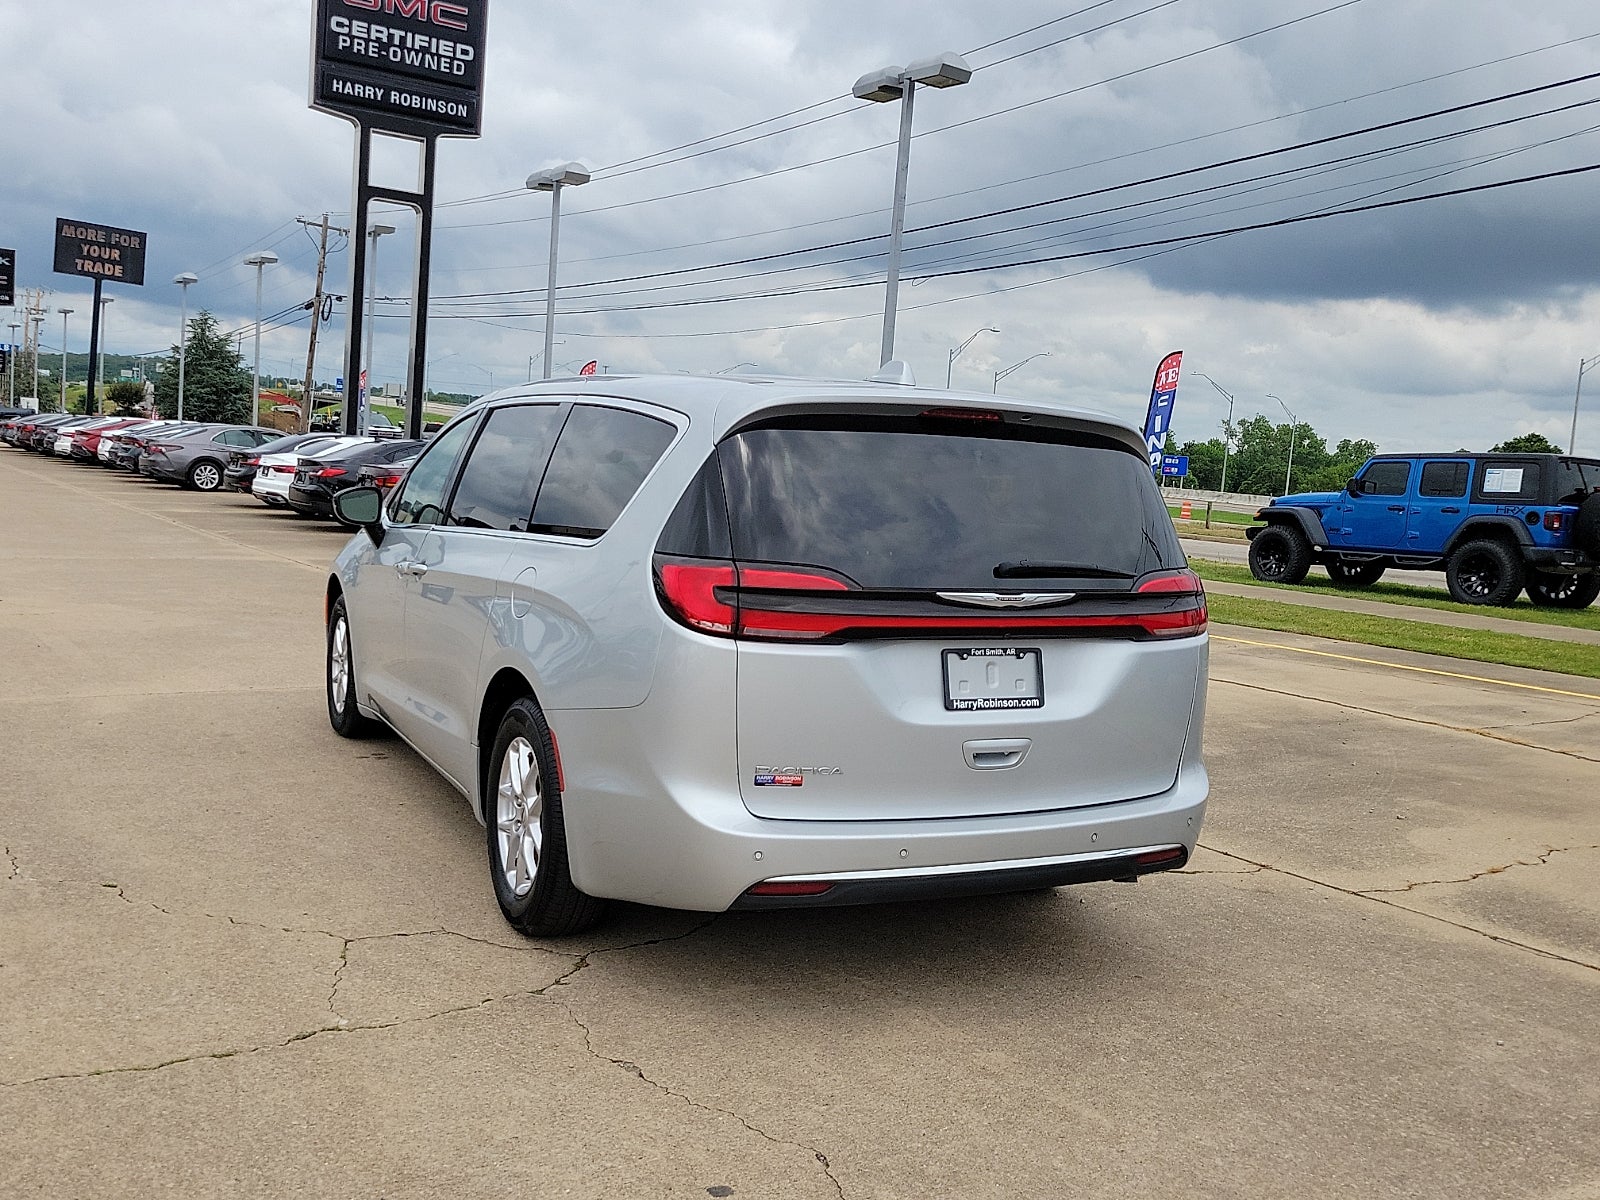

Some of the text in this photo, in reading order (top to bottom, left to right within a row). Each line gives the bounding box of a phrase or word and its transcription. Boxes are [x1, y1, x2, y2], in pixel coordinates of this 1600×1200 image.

[330, 15, 475, 61] CERTIFIED
[338, 35, 465, 76] PRE-OWNED
[332, 78, 468, 118] HARRY ROBINSON
[61, 224, 141, 249] MORE FOR
[80, 243, 121, 261] YOUR
[75, 258, 124, 277] TRADE
[971, 648, 1016, 657] Fort Smith, AR
[953, 698, 1040, 710] HarryRobinson.com
[755, 765, 843, 775] PACIFICA
